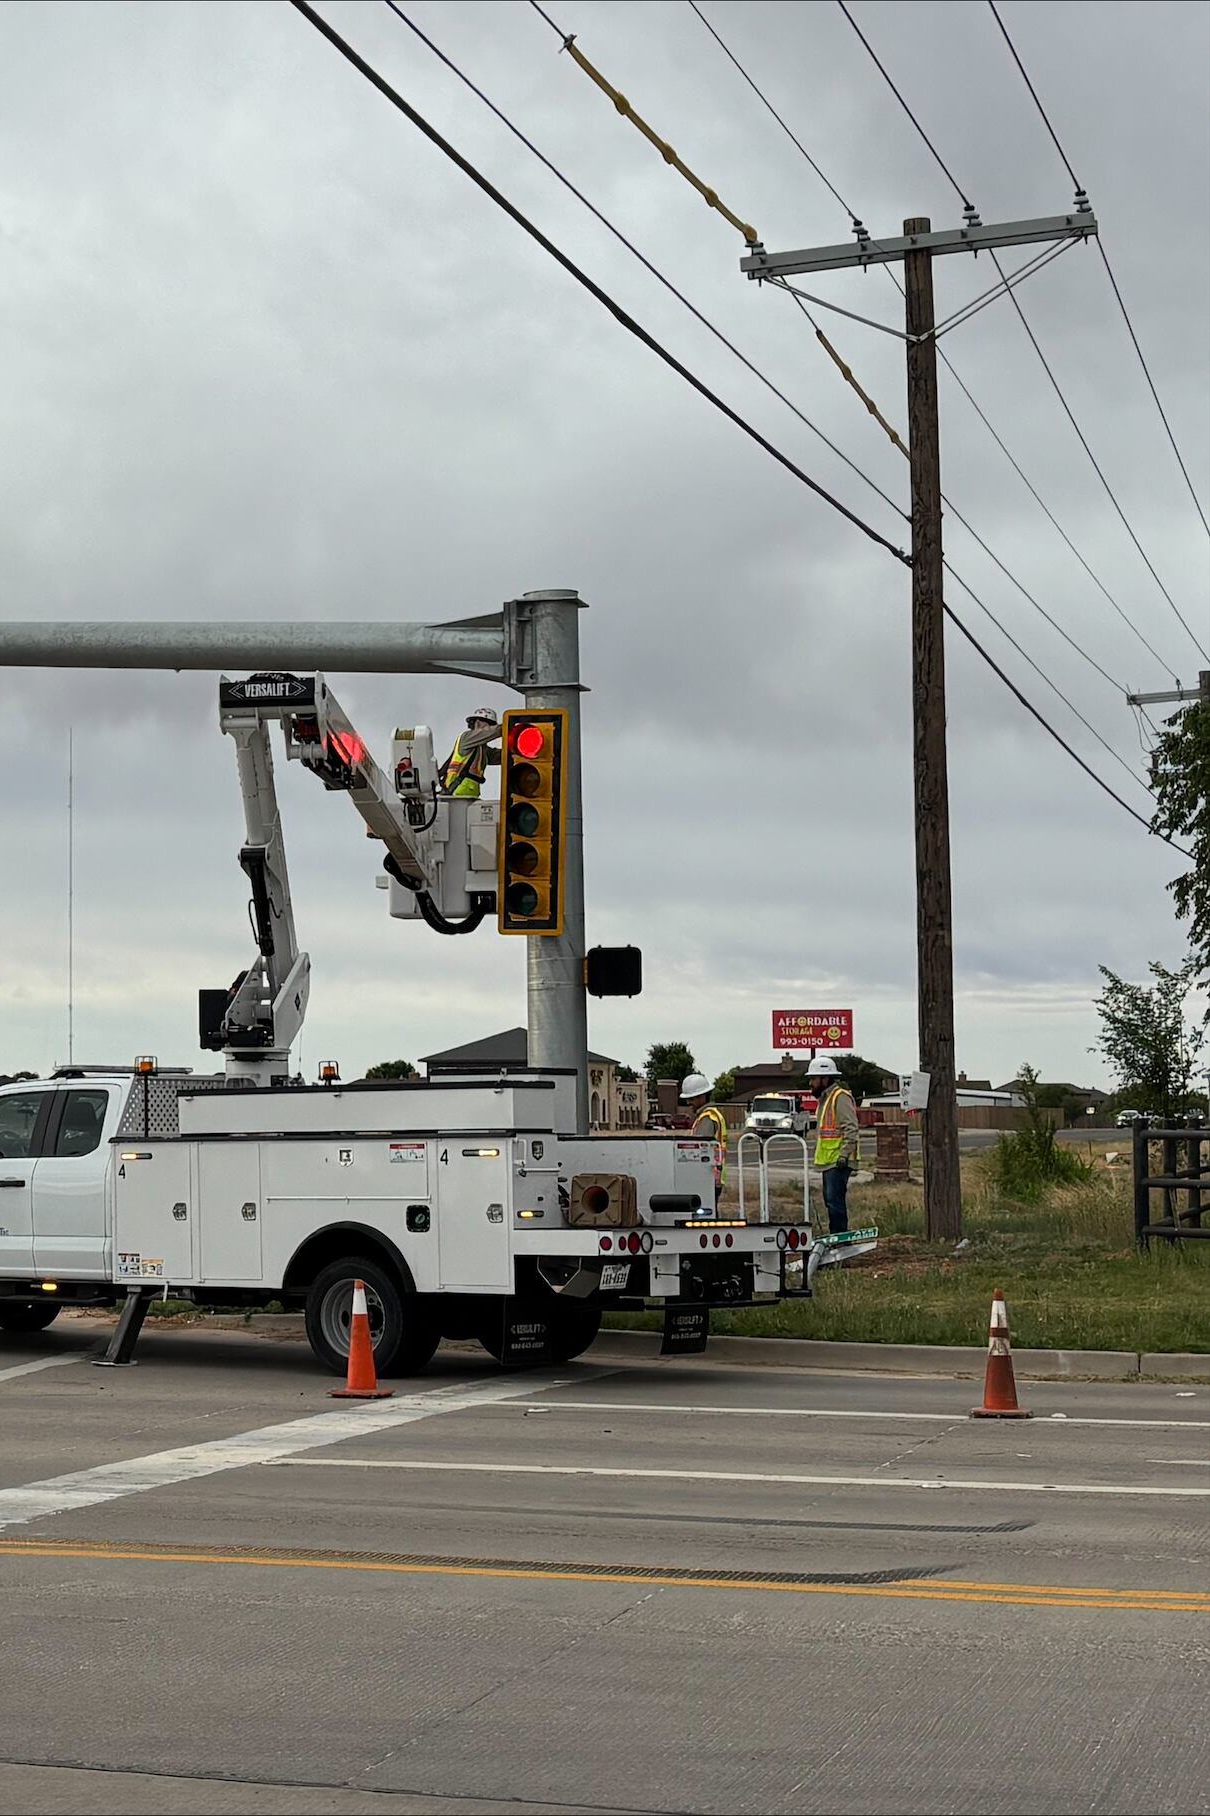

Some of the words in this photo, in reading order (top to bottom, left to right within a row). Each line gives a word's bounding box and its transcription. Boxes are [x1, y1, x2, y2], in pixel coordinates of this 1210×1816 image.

[244, 682, 291, 698] VERSALIFT
[777, 1016, 847, 1027] AFFORDABLE
[781, 1026, 813, 1036] STORAGE
[779, 1037, 824, 1046] 993-0150
[439, 1148, 449, 1166] 4
[118, 1163, 126, 1179] 4
